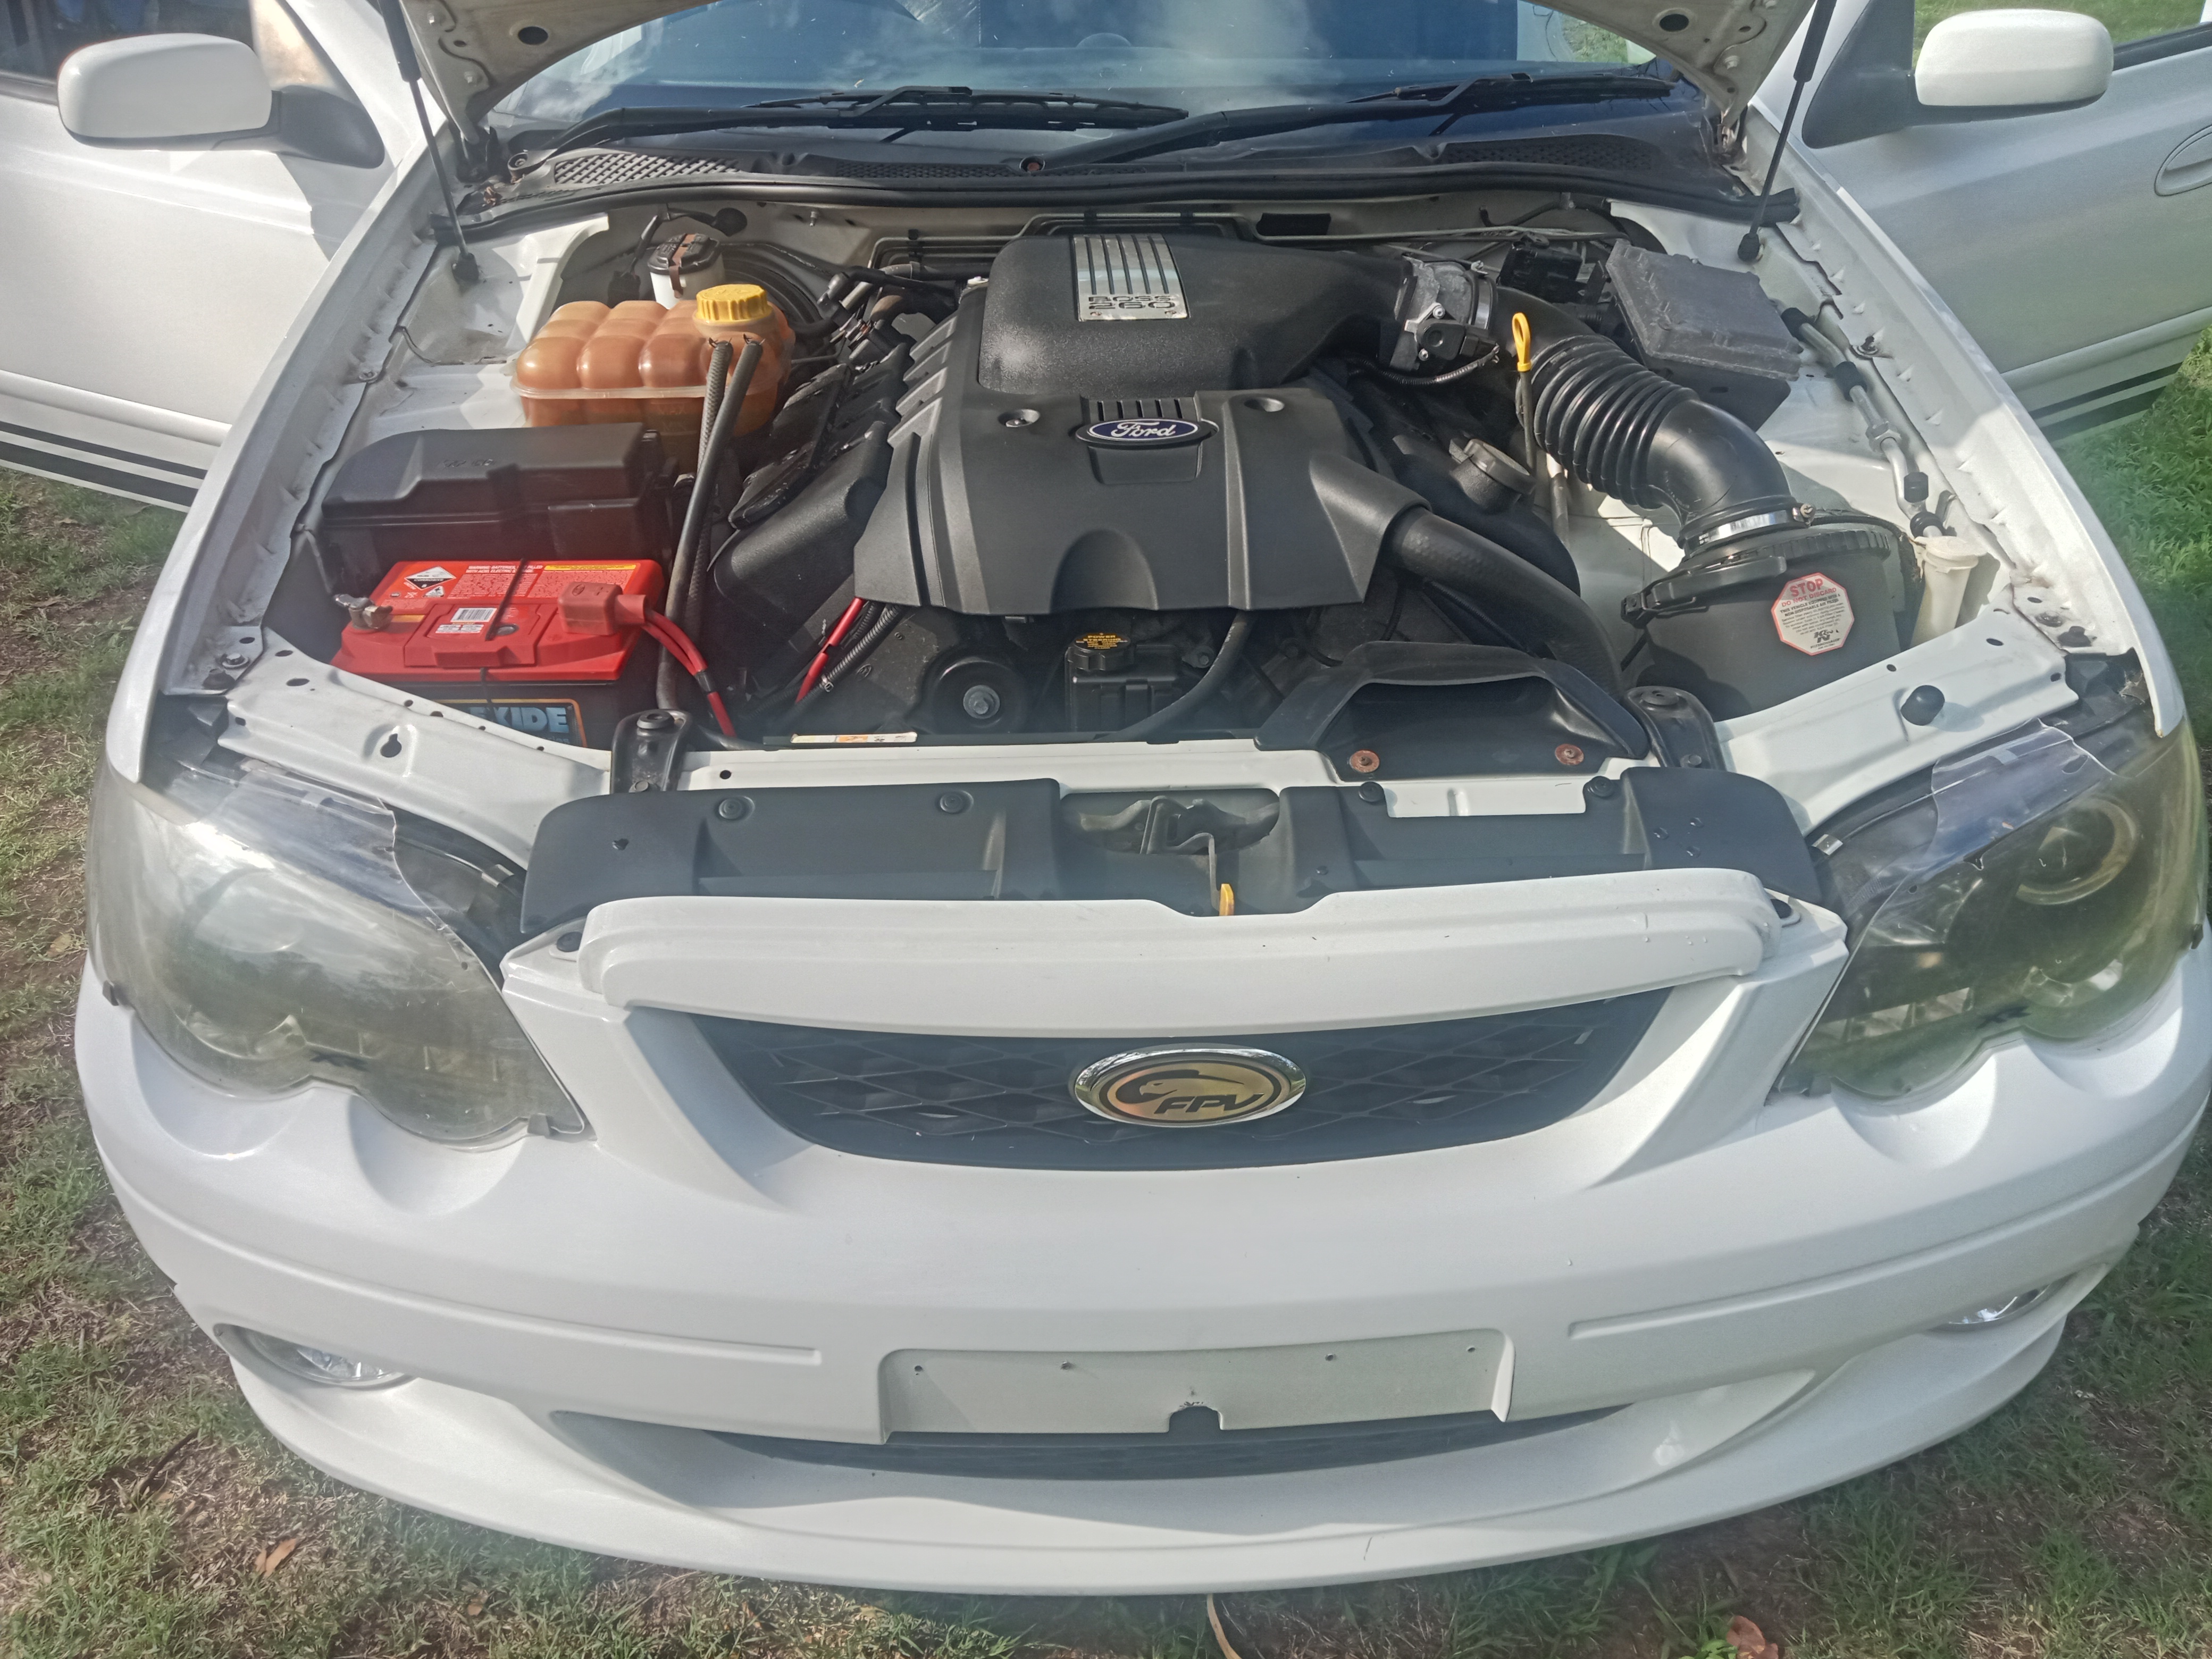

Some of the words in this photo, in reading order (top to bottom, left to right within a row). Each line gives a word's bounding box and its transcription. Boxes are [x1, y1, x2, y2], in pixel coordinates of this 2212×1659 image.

[1111, 422, 1177, 437] Ford
[1789, 578, 1823, 597] STOP
[1792, 595, 1807, 604] NOT
[1809, 588, 1837, 599] DISCARD
[1791, 602, 1808, 612] VEHICLE
[1153, 1093, 1264, 1115] FPV
